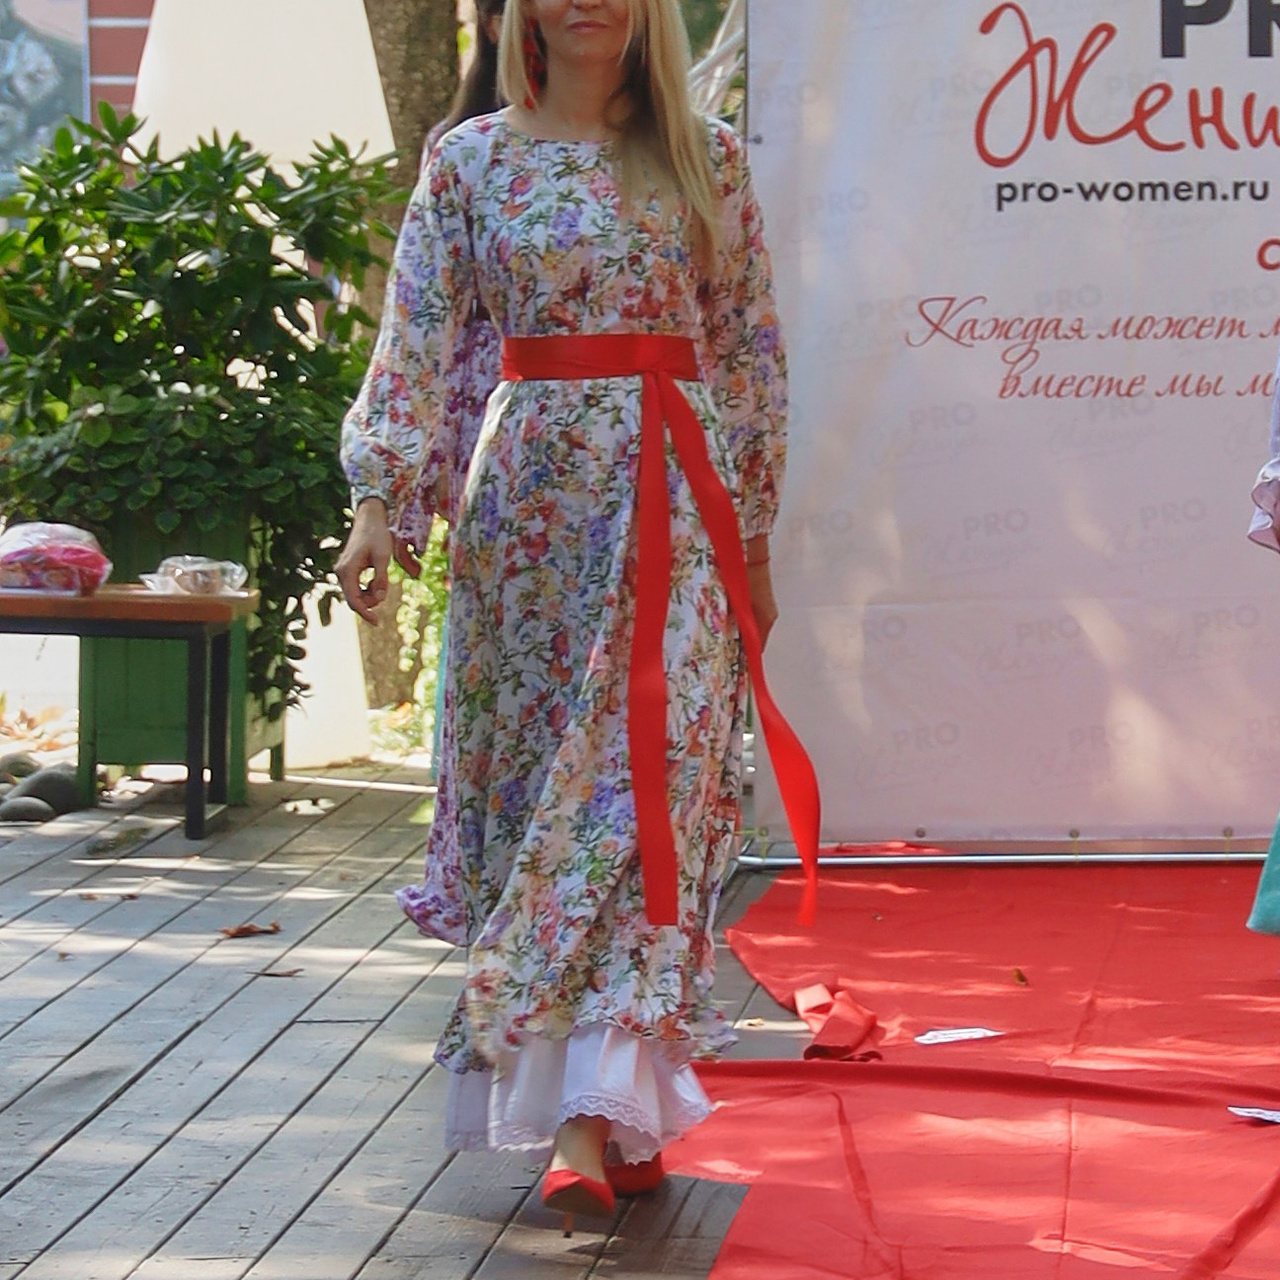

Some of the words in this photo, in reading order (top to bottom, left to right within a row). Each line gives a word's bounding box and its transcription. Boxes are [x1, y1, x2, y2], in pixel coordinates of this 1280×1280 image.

[995, 179, 1270, 212] pro-women.ru
[904, 295, 1089, 348] Каждая
[1097, 314, 1248, 341] может
[998, 341, 1147, 400] вместе
[1154, 372, 1225, 399] мы
